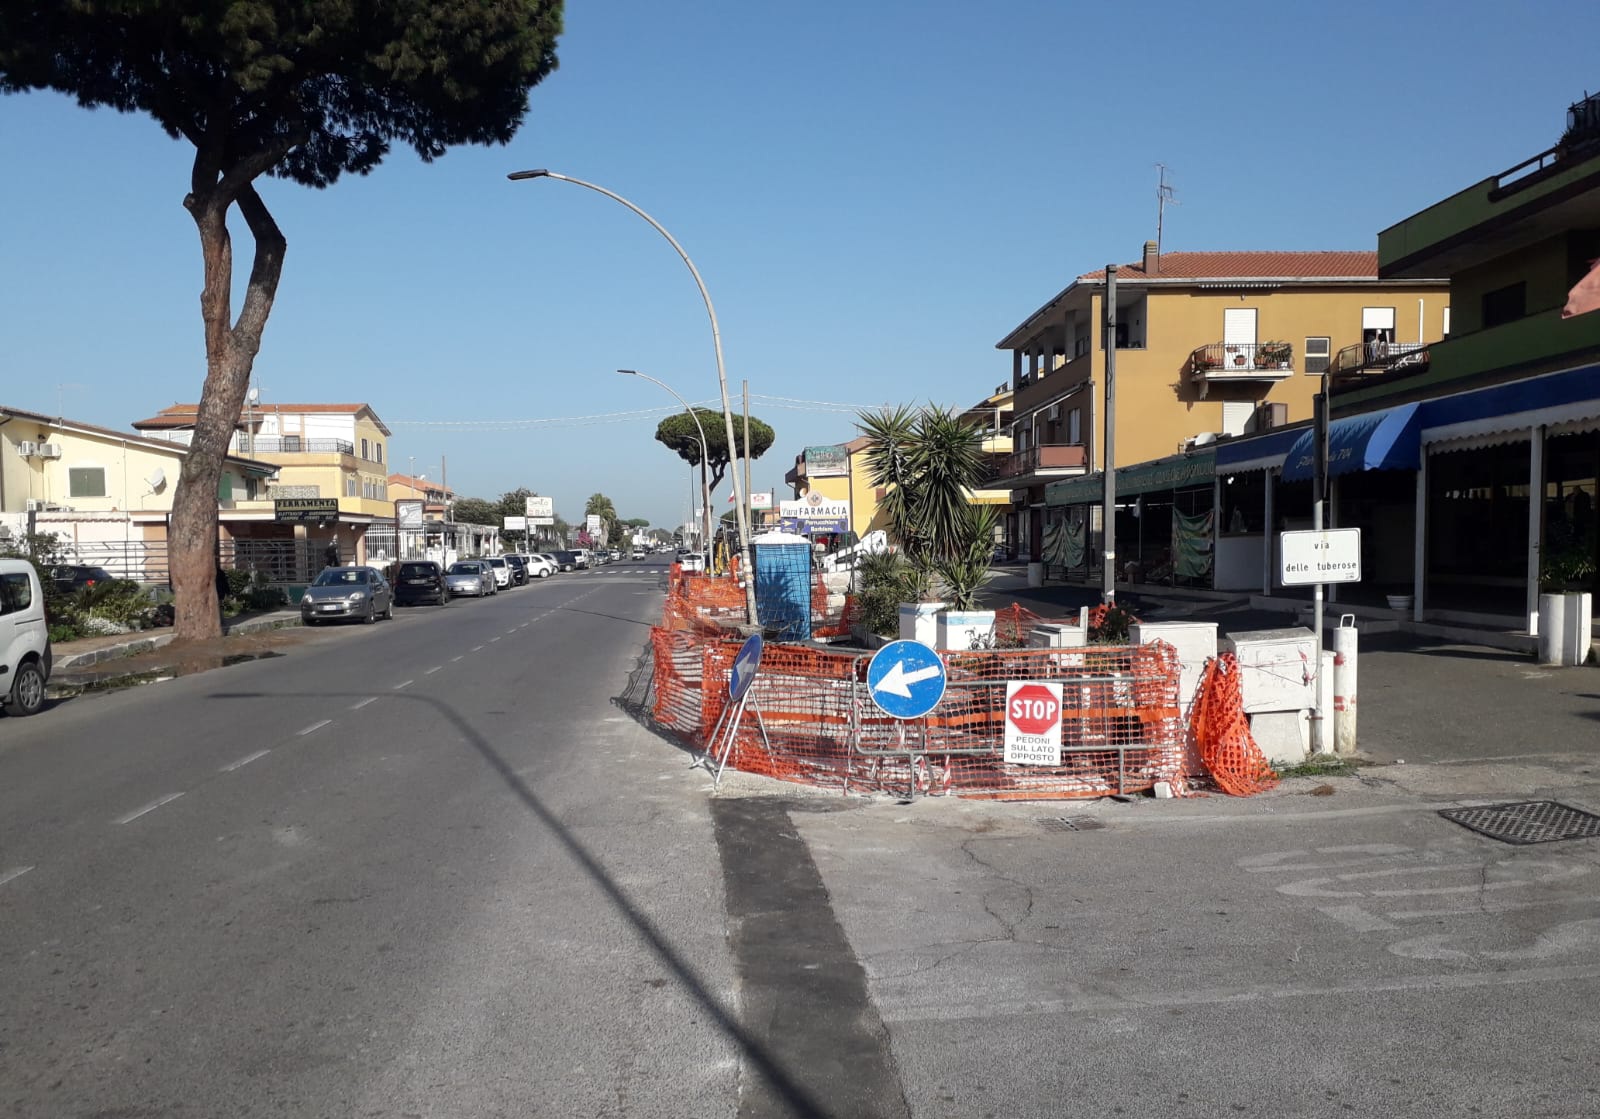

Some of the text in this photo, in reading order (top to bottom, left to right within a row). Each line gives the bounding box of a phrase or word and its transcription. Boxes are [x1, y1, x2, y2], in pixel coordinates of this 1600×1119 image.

[277, 500, 336, 508] FERRAMENTA
[799, 507, 847, 516] FARMACIA
[1313, 540, 1330, 550] via
[1286, 561, 1357, 572] delle tuberose
[1012, 699, 1056, 720] STOP
[1016, 736, 1050, 745] PEDONI
[1010, 744, 1055, 754] SUL LATO
[1010, 752, 1055, 762] OPPOSTO
